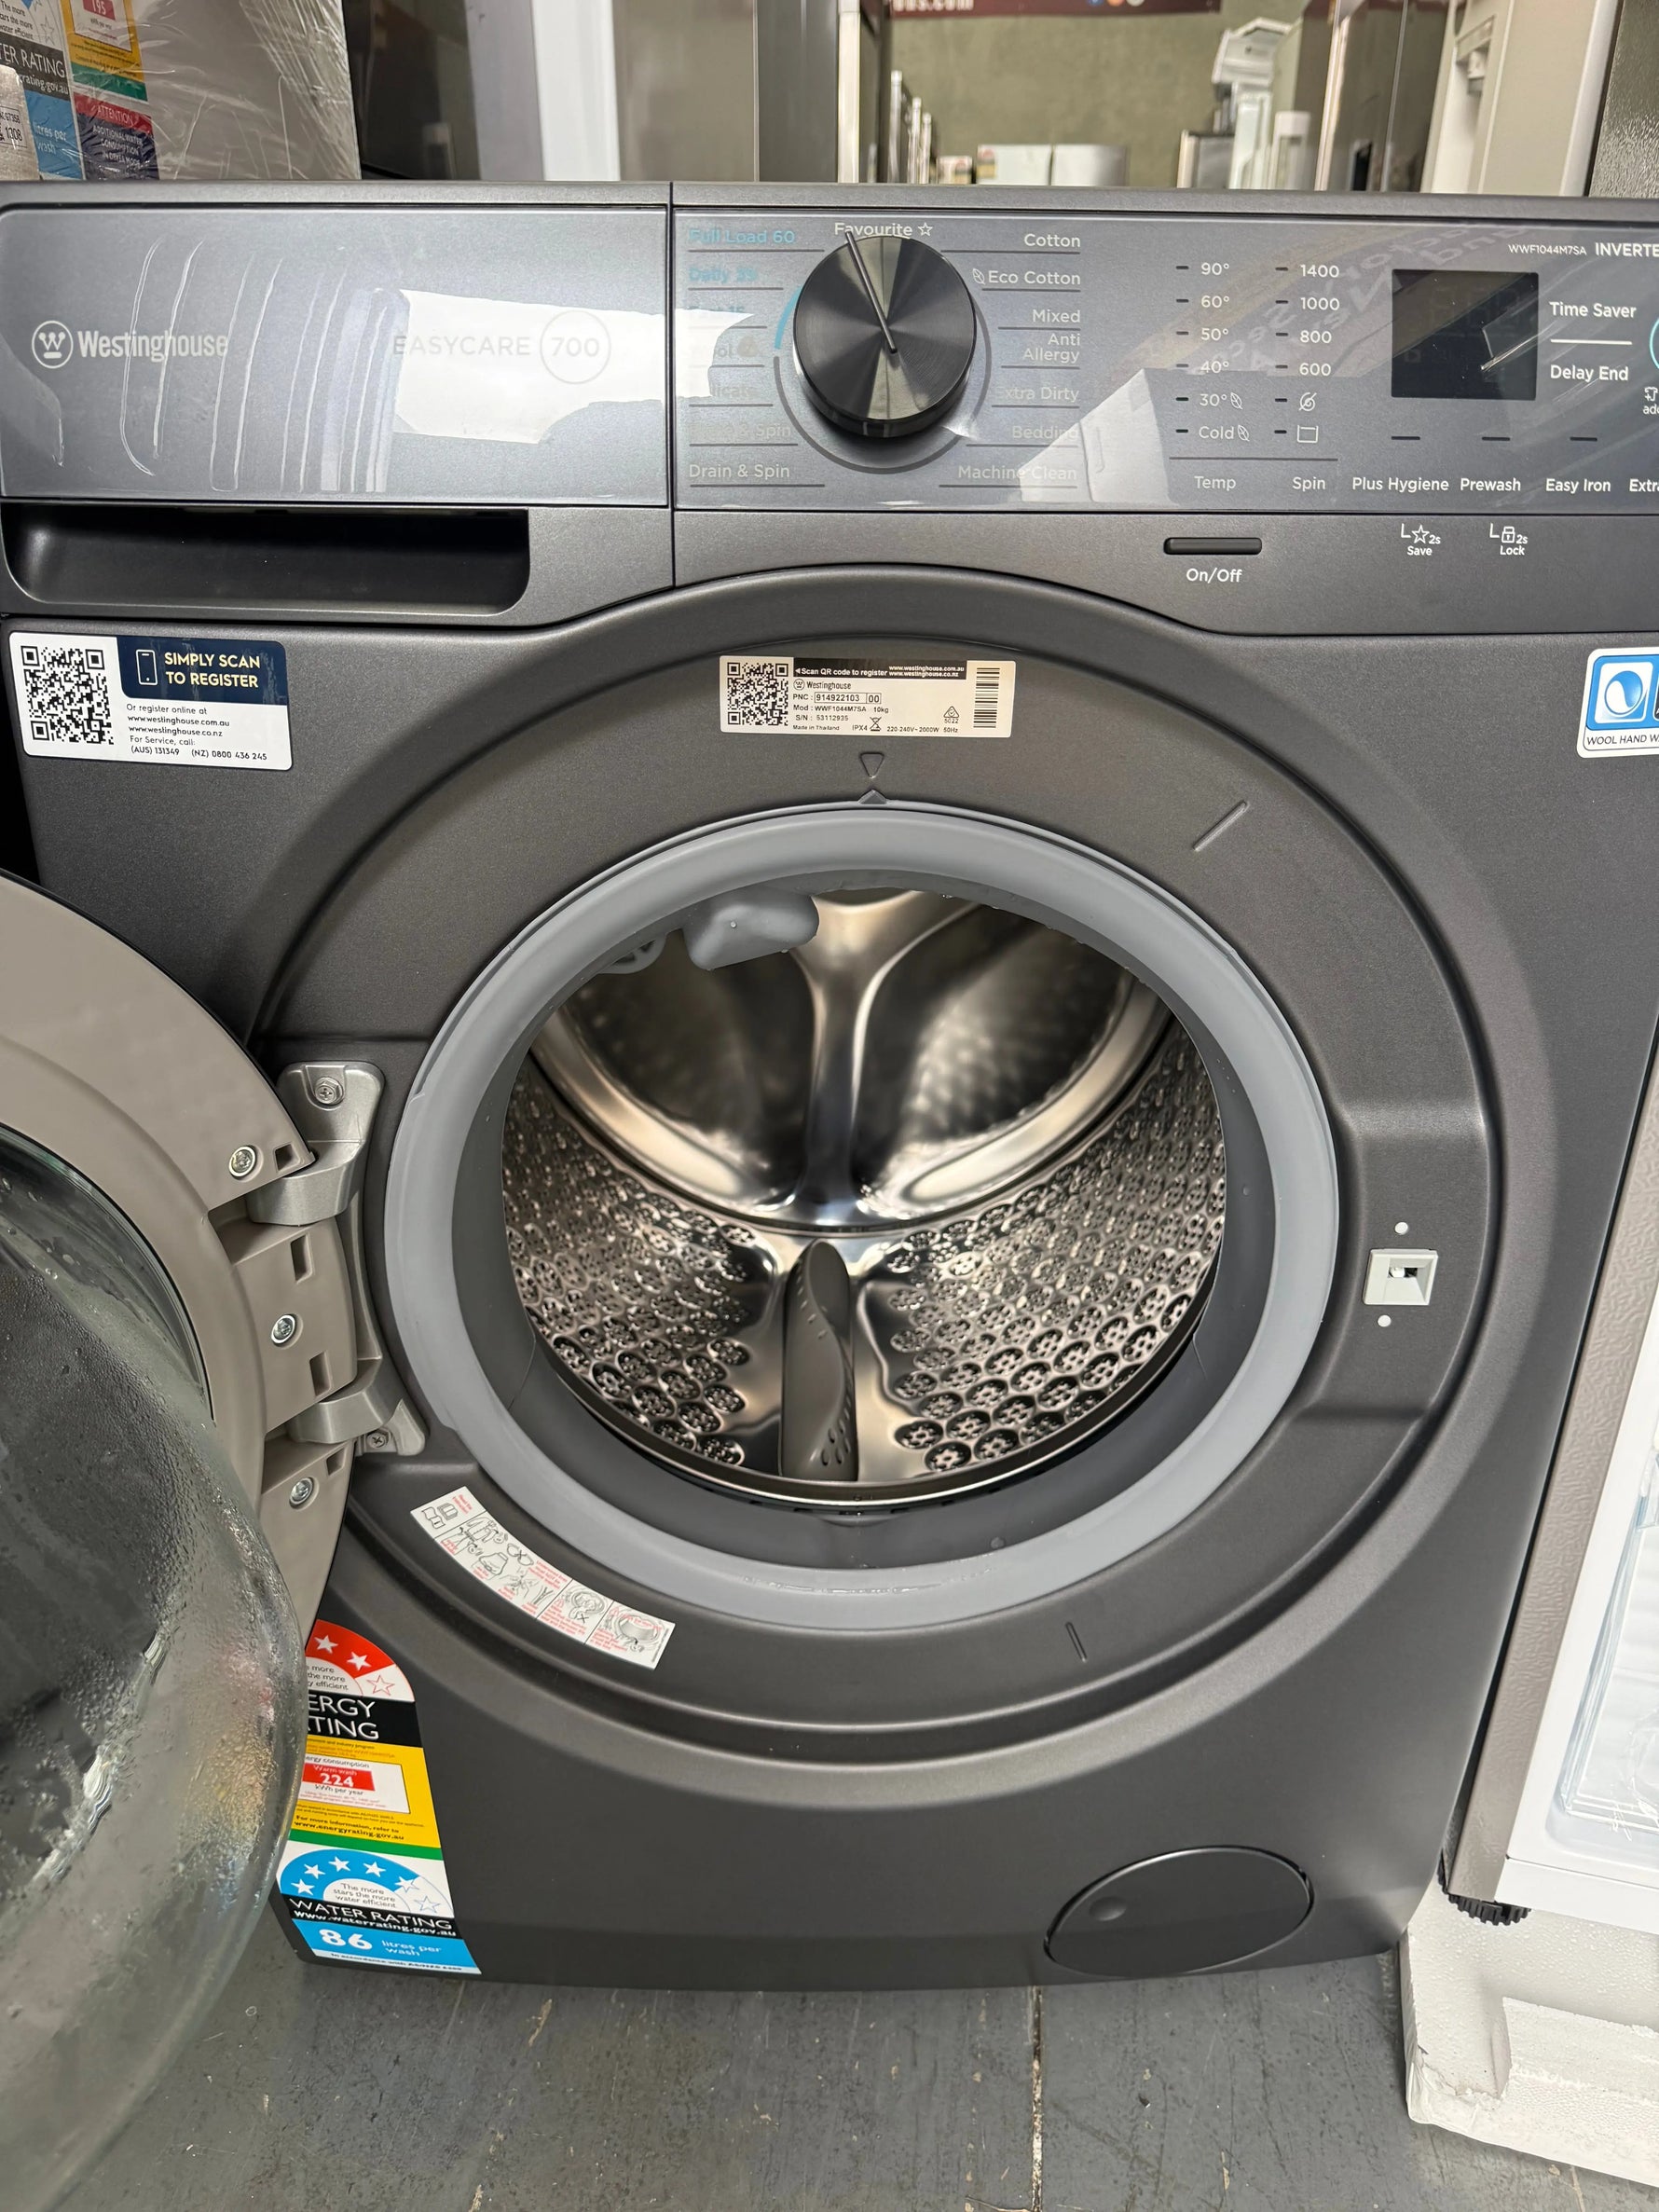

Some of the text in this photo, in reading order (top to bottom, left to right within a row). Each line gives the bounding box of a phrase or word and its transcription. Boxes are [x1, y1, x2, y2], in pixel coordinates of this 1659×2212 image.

[0, 42, 19, 66] TER
[21, 48, 66, 78] RATING
[98, 105, 134, 127] ATTENTION
[726, 229, 767, 243] Load
[773, 229, 796, 243] 60
[834, 222, 913, 237] Favourite
[1024, 233, 1080, 248] Cotton
[1508, 242, 1659, 257] WWF1044M7SA INVERTE
[988, 270, 1080, 285] Eco Cotton
[1200, 262, 1339, 278] 90° 1400
[1200, 295, 1340, 310] 60° 1000
[1549, 301, 1637, 318] Time Saver
[1032, 309, 1080, 323] Mixed
[1048, 334, 1080, 346] Anti
[1200, 327, 1332, 344] 50° 800
[77, 330, 227, 363] Westinghouse
[393, 335, 600, 357] EASYCARE 700
[1022, 348, 1080, 364] Allergy
[1200, 361, 1331, 377] 40° 600
[1550, 364, 1629, 382] Delay End
[994, 386, 1080, 402] Extra Dirty
[1200, 393, 1227, 406] 30°
[1642, 404, 1659, 416] ad
[756, 424, 791, 438] Spin
[1012, 425, 1079, 443] Bedding
[1199, 426, 1235, 439] Cold
[690, 464, 790, 480] Drain & Spin
[958, 465, 1076, 479] Machine Clean
[1194, 475, 1236, 492] Temp
[1292, 476, 1326, 492] Spin
[1351, 476, 1449, 493] Plus Hygiene
[1460, 477, 1521, 491] Prewash
[1545, 478, 1611, 494] Easy Iron
[1407, 545, 1433, 556] Save
[1500, 545, 1525, 556] Lock
[1186, 567, 1242, 584] On/Off
[164, 652, 260, 668] SIMPLY SCAN
[166, 671, 258, 688] TO REGISTER
[860, 669, 887, 678] register
[806, 681, 851, 691] Westinghouse
[816, 694, 860, 702] 914922103
[868, 694, 880, 703] 00
[126, 703, 136, 711] Or
[139, 704, 169, 714] register
[171, 707, 197, 715] online
[127, 714, 230, 727] www.westinghouse.com.au
[129, 725, 223, 736] www.westinghouse.co.nz
[130, 735, 143, 744] For
[144, 735, 176, 746] Service,
[1587, 734, 1659, 745] WOOL HAND W
[130, 745, 267, 761] (AUS) 131349 (NZ) 0800 436 245
[322, 1674, 346, 1683] more
[316, 1682, 349, 1692] efficient
[308, 1695, 376, 1719] ERGY
[308, 1716, 379, 1740] TING
[313, 1765, 357, 1777] Warm wash
[322, 1758, 370, 1769] consumption
[320, 1773, 354, 1788] 224
[349, 1788, 364, 1796] year
[295, 1821, 404, 1840] www.energyrating.gov.au
[340, 1882, 385, 1894] The more
[333, 1889, 396, 1903] stars the more
[336, 1895, 396, 1908] water efficient
[289, 1898, 453, 1930] WATER RATING
[294, 1910, 457, 1937] www.waterrating.gov.au
[319, 1929, 373, 1950] 86
[381, 1939, 443, 1954] litres per
[385, 1947, 420, 1957] wash
